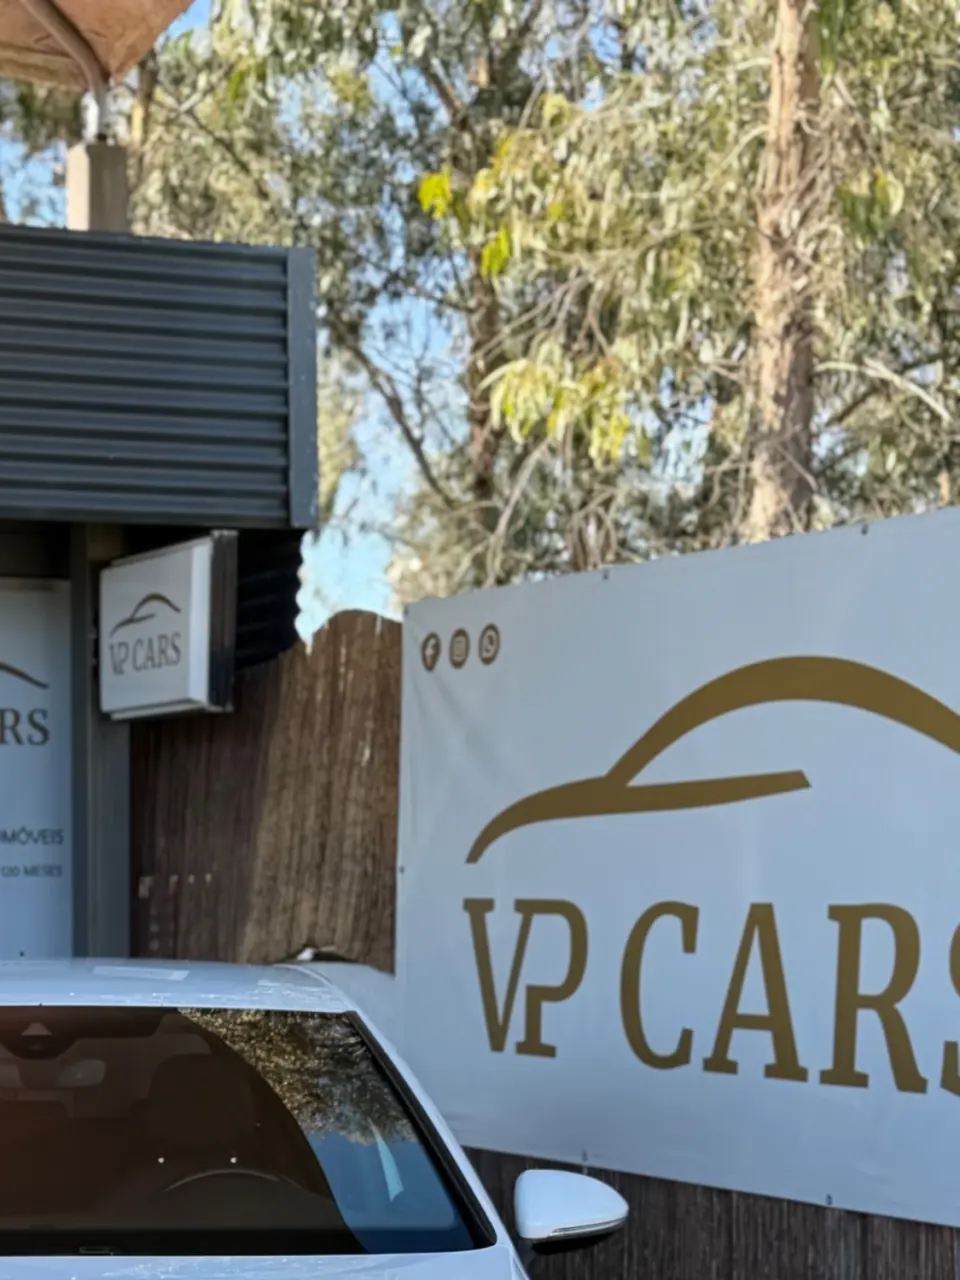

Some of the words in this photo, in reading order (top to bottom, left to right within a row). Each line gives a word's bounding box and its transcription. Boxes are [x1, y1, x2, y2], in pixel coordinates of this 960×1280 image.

[109, 641, 130, 676] VP
[132, 632, 182, 673] CARS
[22, 864, 63, 878] MESES
[463, 897, 588, 1059] VP
